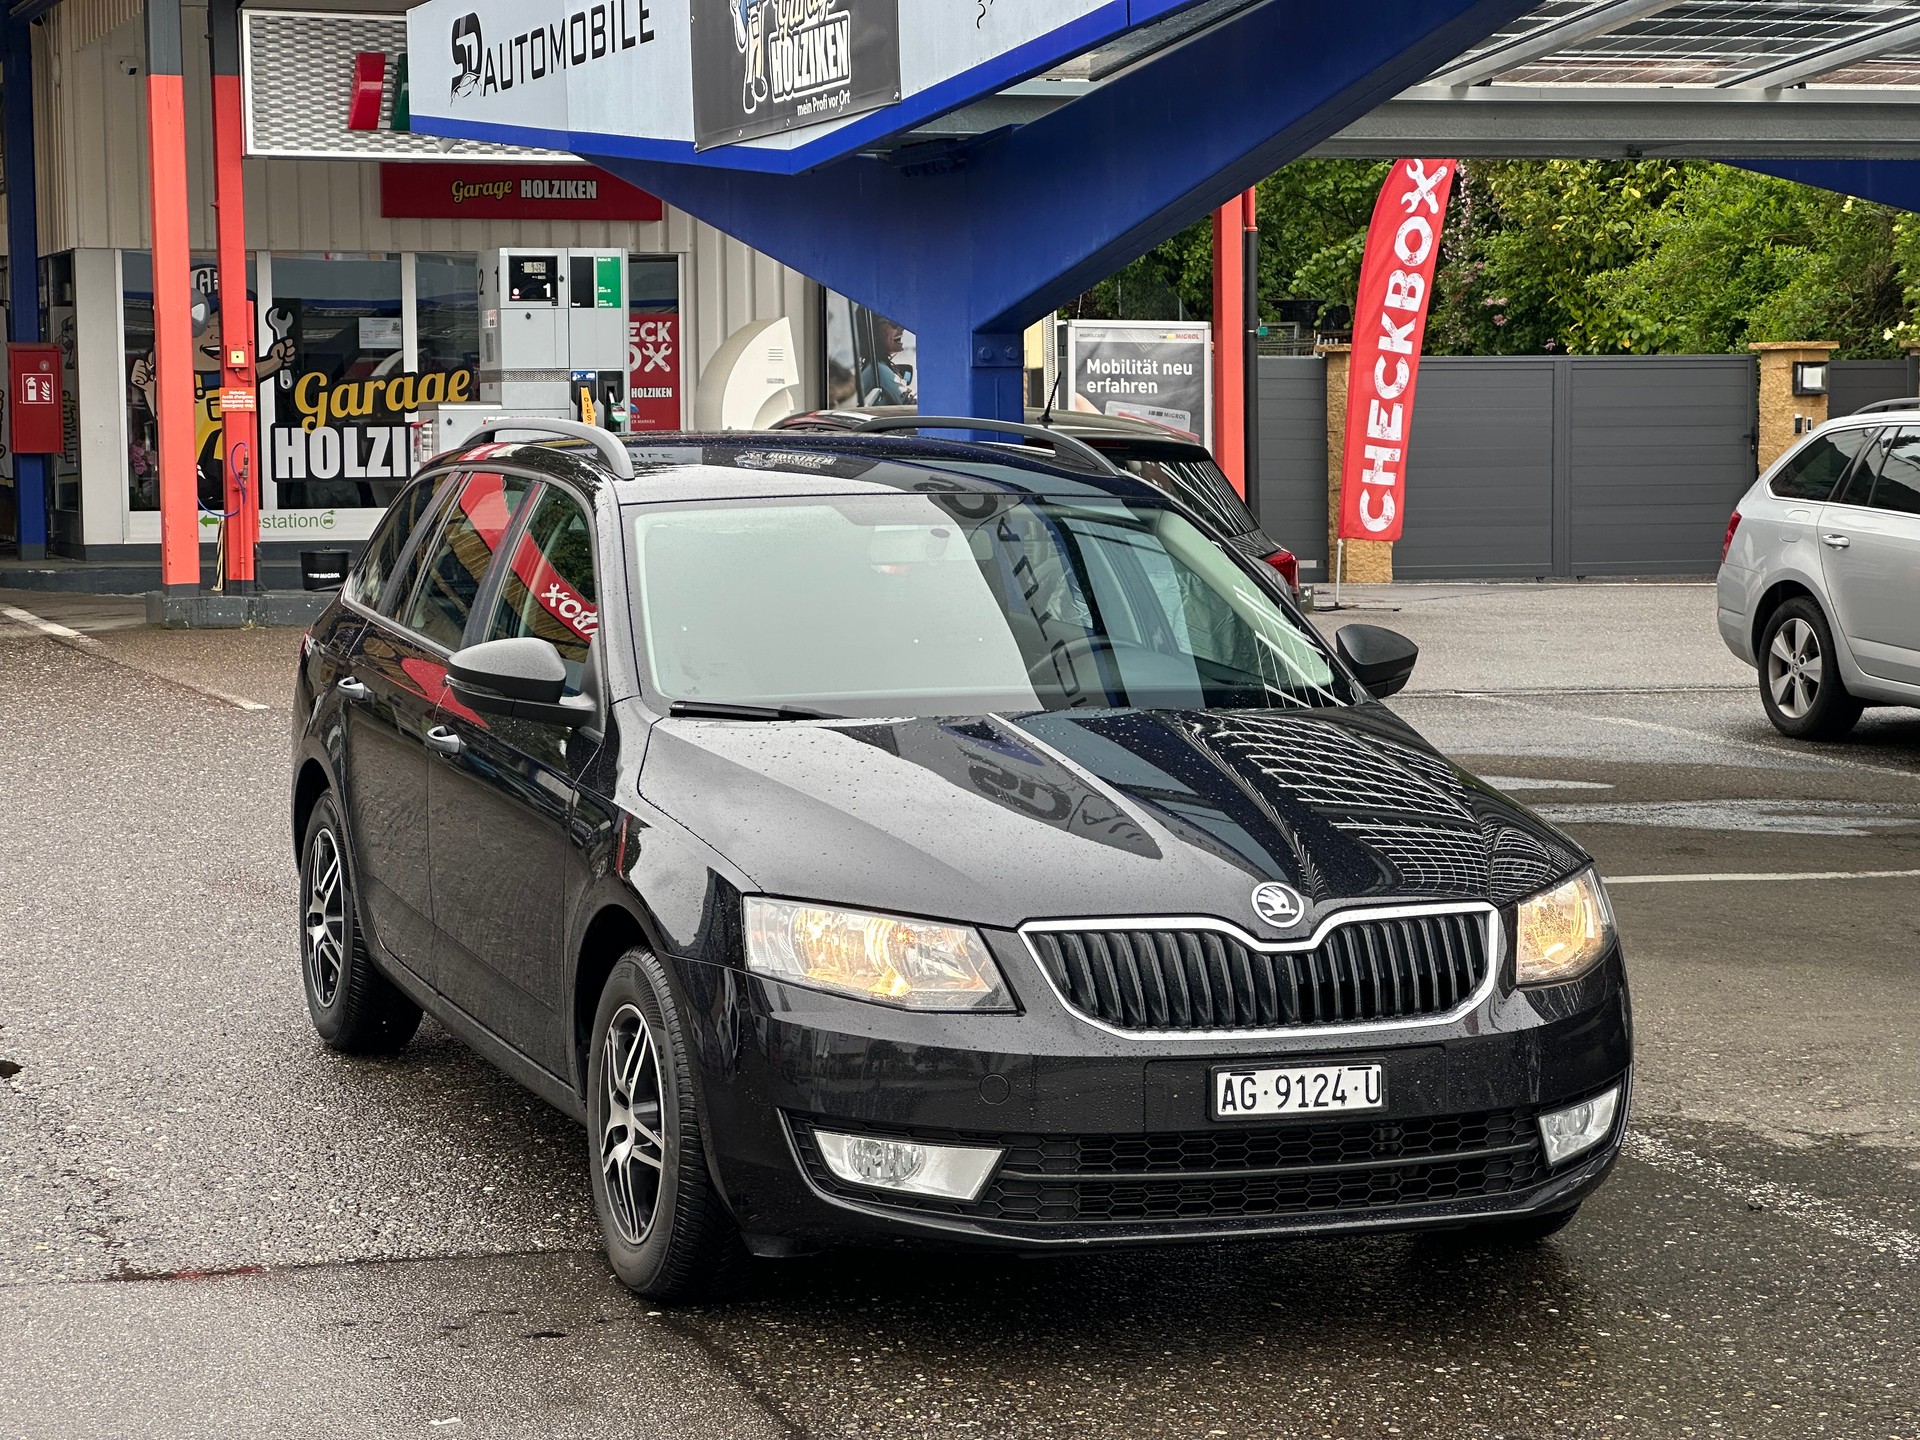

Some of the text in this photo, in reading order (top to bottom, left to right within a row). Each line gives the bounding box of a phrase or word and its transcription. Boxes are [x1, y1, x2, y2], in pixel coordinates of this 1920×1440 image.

[483, 0, 655, 97] AUTOMOBILE
[771, 19, 849, 94] HOLZIKEN
[797, 89, 850, 116] mein Profi vor Ort
[451, 180, 597, 202] Garage HOLZIKEN
[542, 282, 552, 298] 1
[1358, 158, 1448, 532] CHECKBOX
[1086, 358, 1193, 375] Mobilität neu
[631, 387, 673, 398] HOLZIKEN
[1086, 378, 1158, 393] erfahren
[295, 370, 470, 434] Garage
[583, 397, 593, 424] DIES
